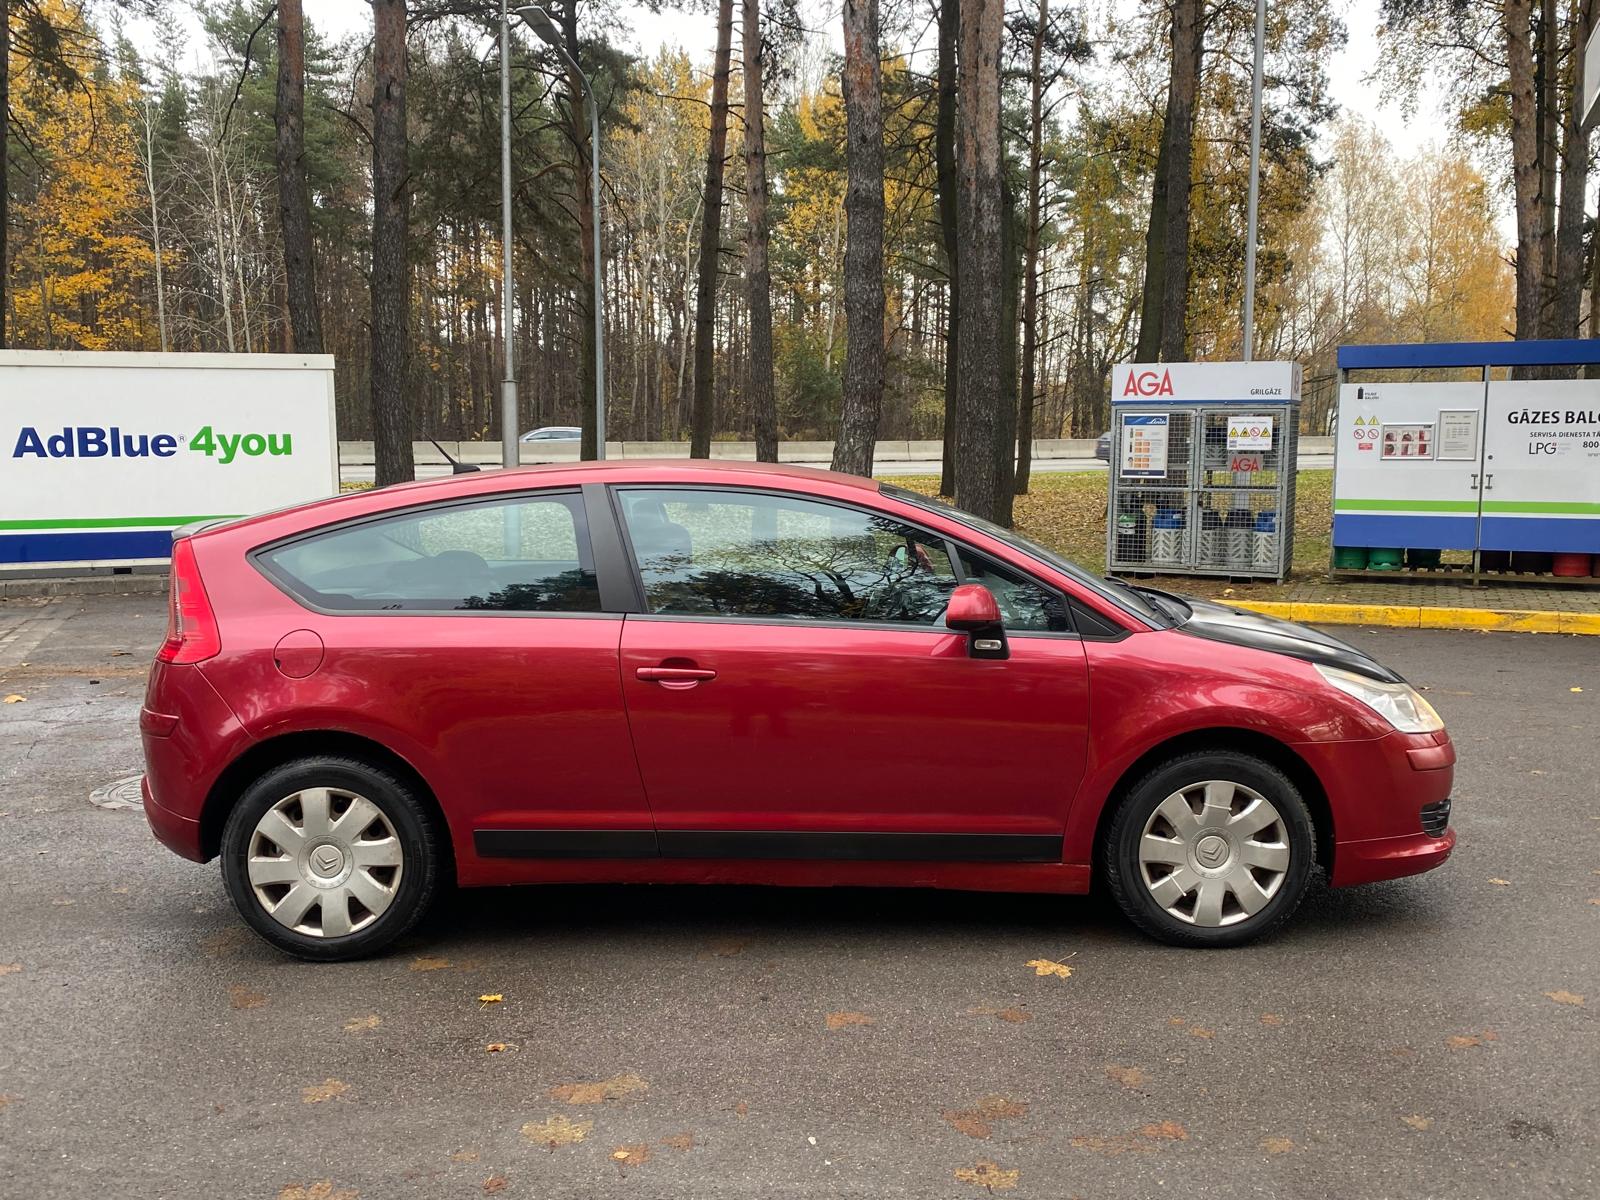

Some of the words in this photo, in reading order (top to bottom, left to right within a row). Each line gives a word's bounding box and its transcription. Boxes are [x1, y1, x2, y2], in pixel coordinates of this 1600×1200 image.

[1123, 367, 1174, 396] AGA
[1507, 408, 1560, 424] GĀZES
[1564, 410, 1600, 424] BAL
[189, 426, 293, 465] 4you
[1528, 442, 1557, 455] LPG
[1582, 440, 1600, 448] 800
[1230, 457, 1260, 472] AGA
